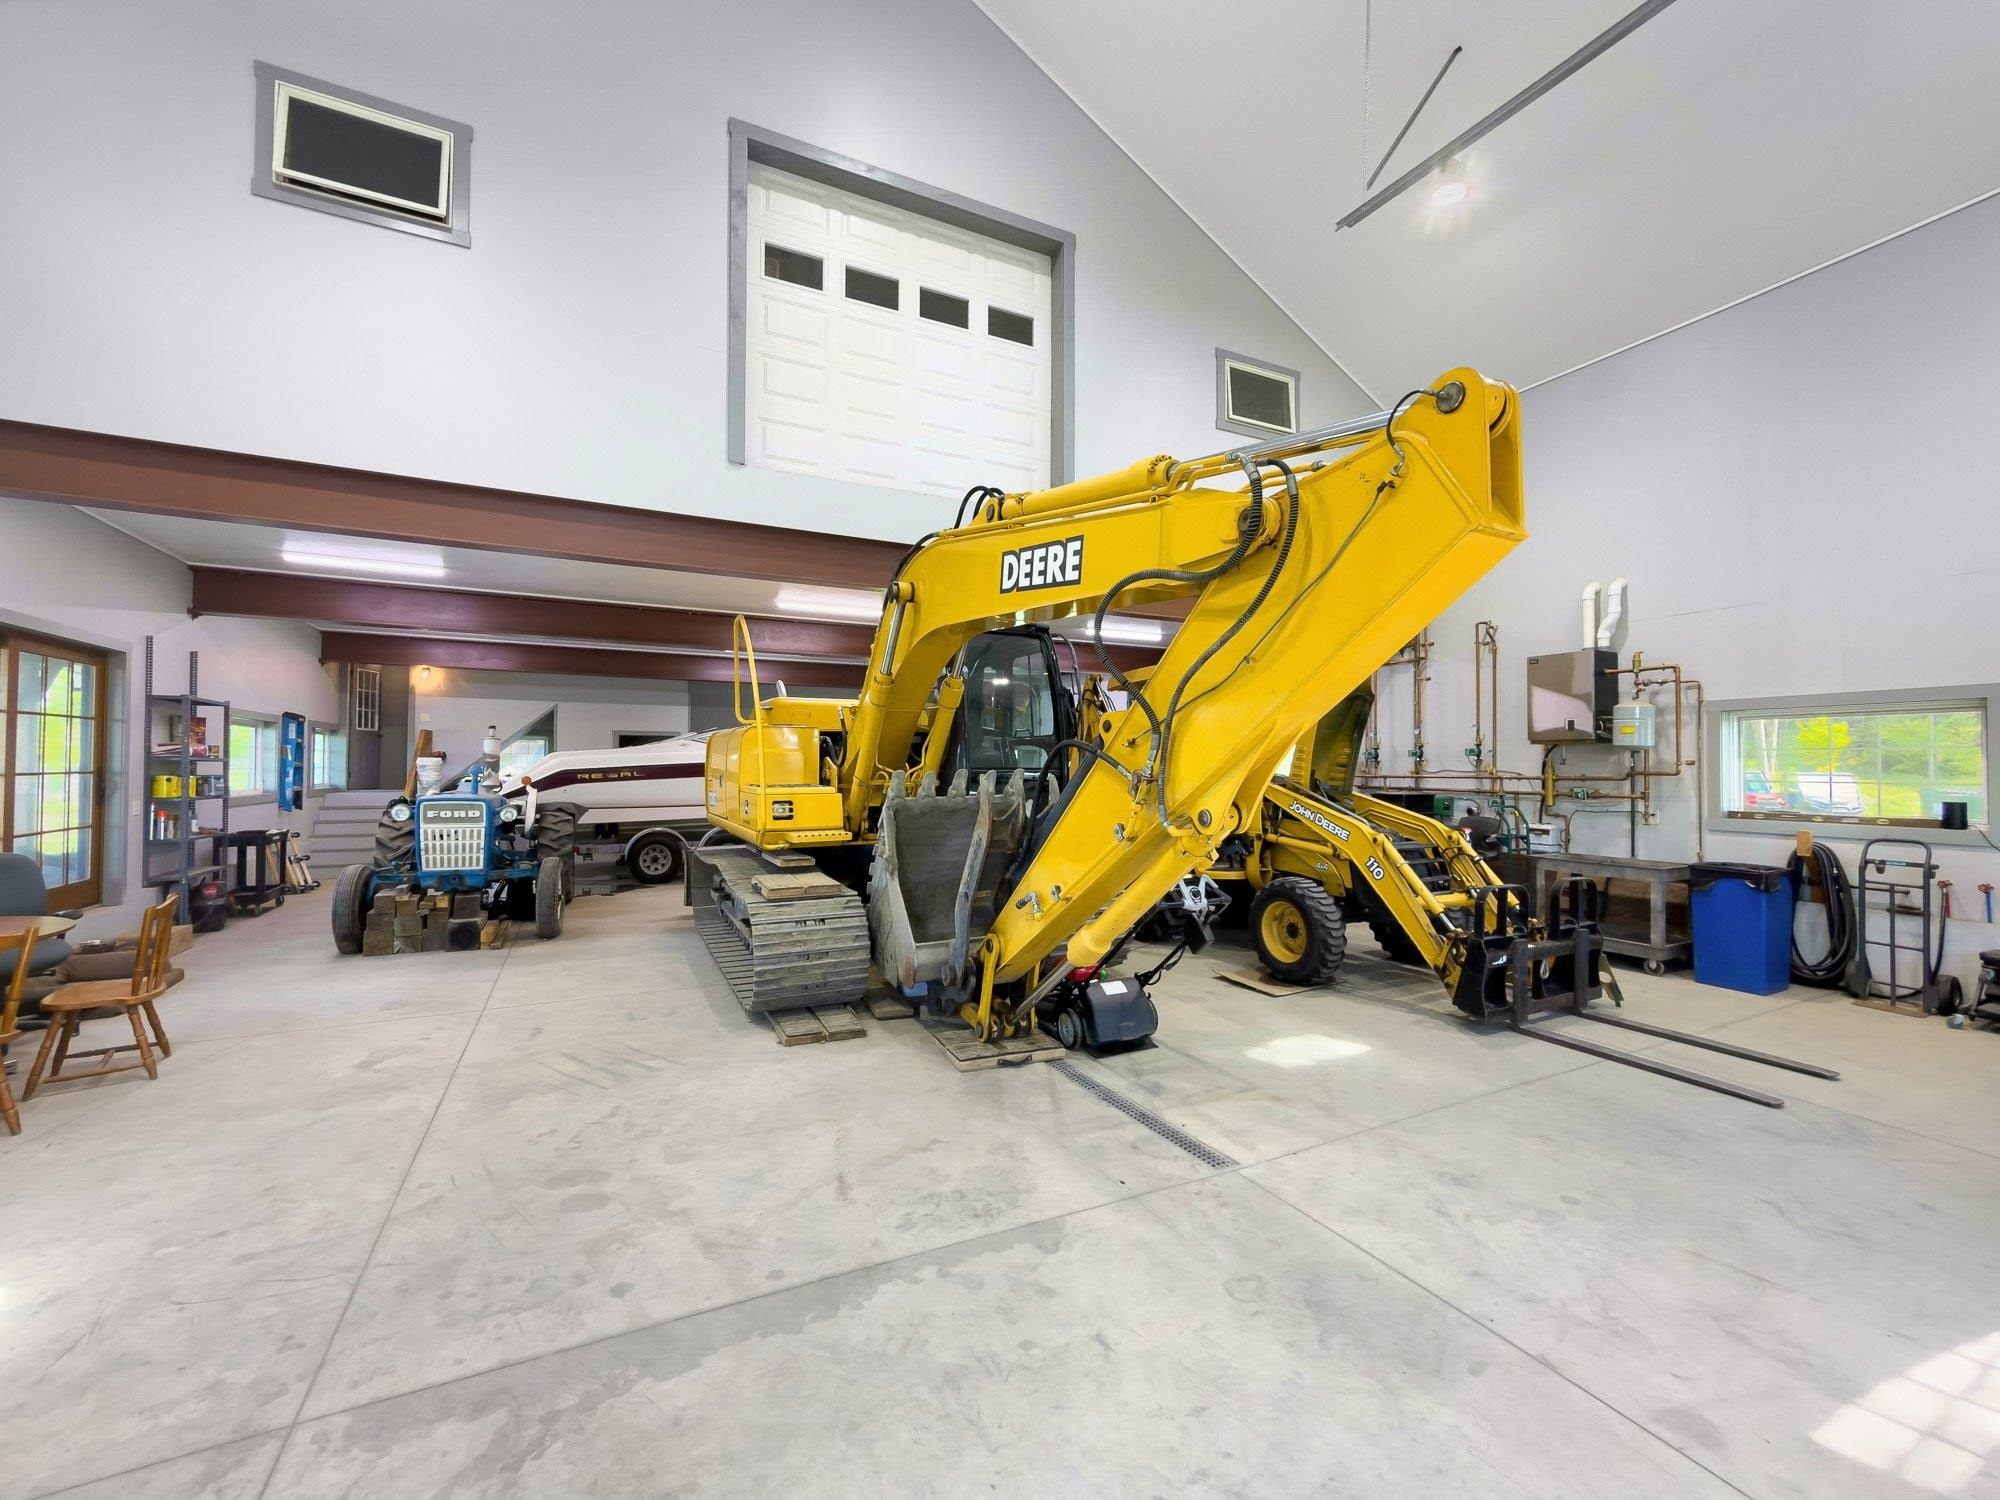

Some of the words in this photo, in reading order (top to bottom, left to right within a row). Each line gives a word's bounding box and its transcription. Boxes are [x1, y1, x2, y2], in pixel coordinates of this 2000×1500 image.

[1001, 538, 1082, 591] DEERE
[426, 810, 480, 818] FORD
[1289, 800, 1315, 822] JOHN
[1315, 813, 1350, 841] DEERE
[1365, 856, 1384, 880] 110
